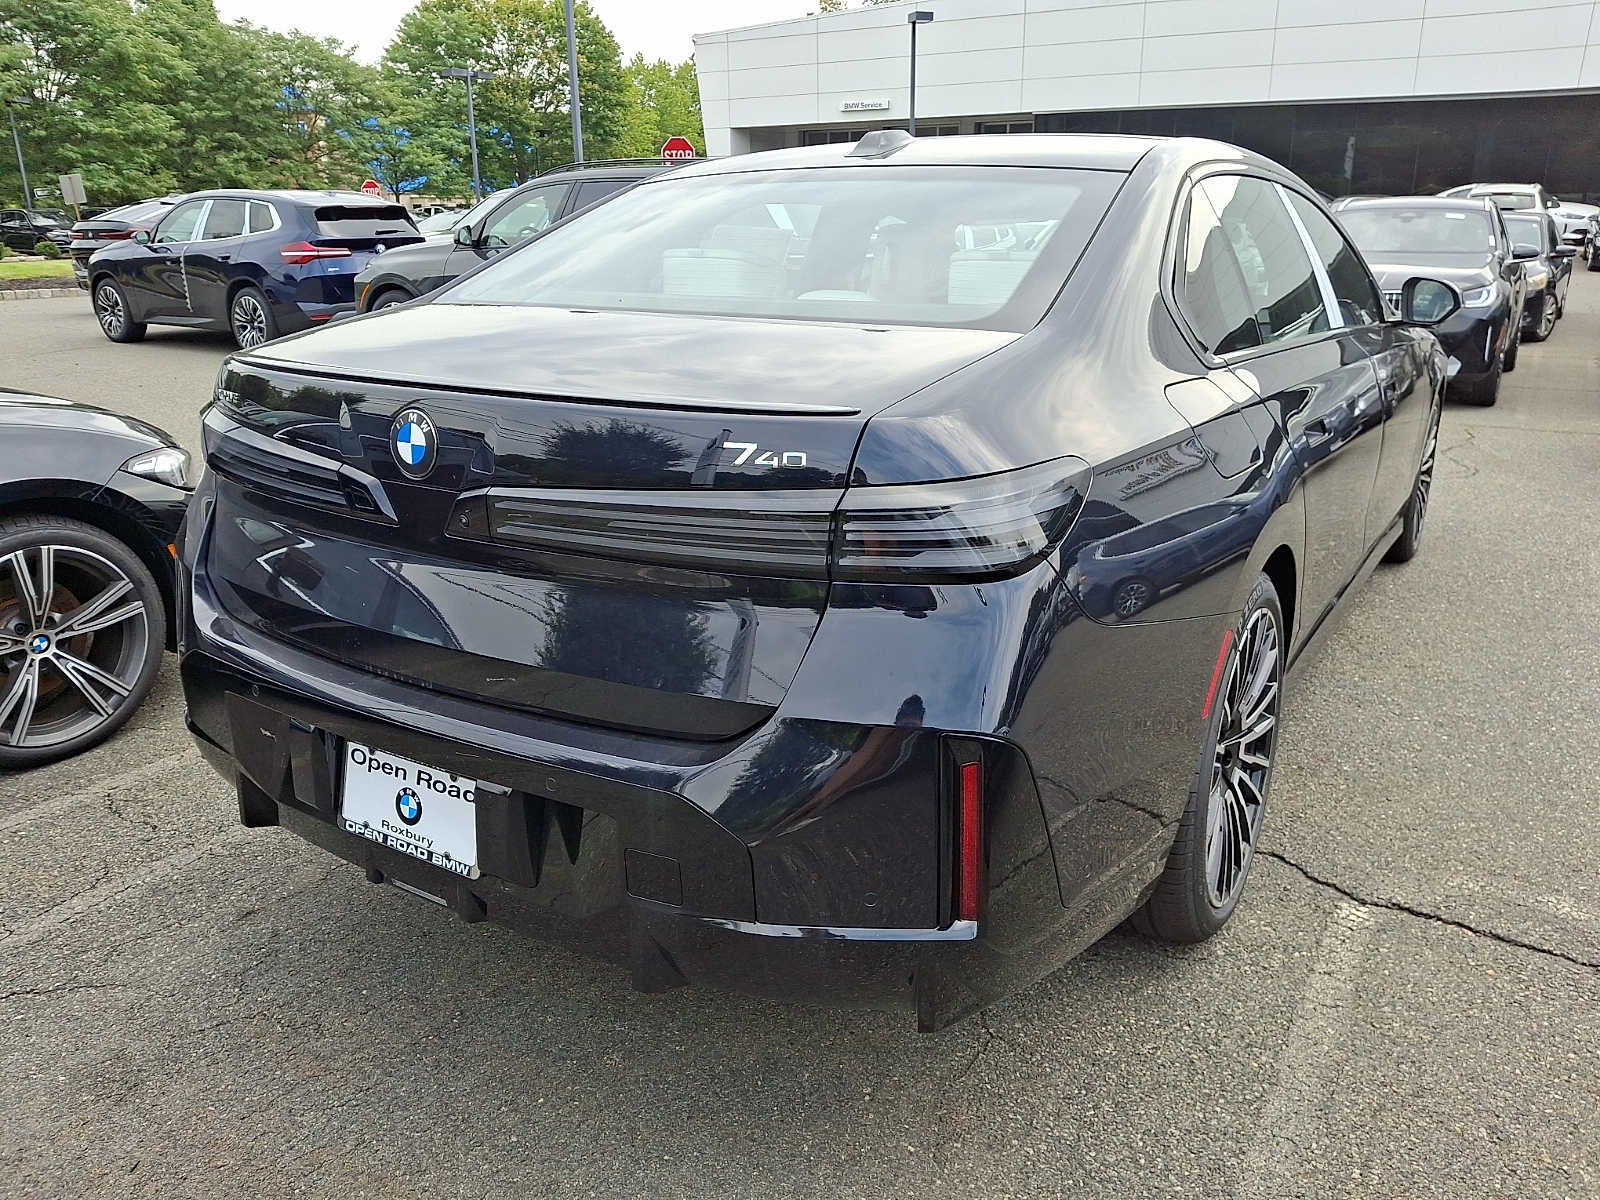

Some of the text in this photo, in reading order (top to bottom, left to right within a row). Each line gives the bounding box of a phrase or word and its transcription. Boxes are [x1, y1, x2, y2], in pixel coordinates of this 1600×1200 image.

[396, 412, 430, 433] BMW
[722, 441, 807, 469] 740
[350, 747, 408, 781] Open
[345, 820, 470, 877] OPEN ROAD BMW
[381, 819, 434, 849] Roxbury
